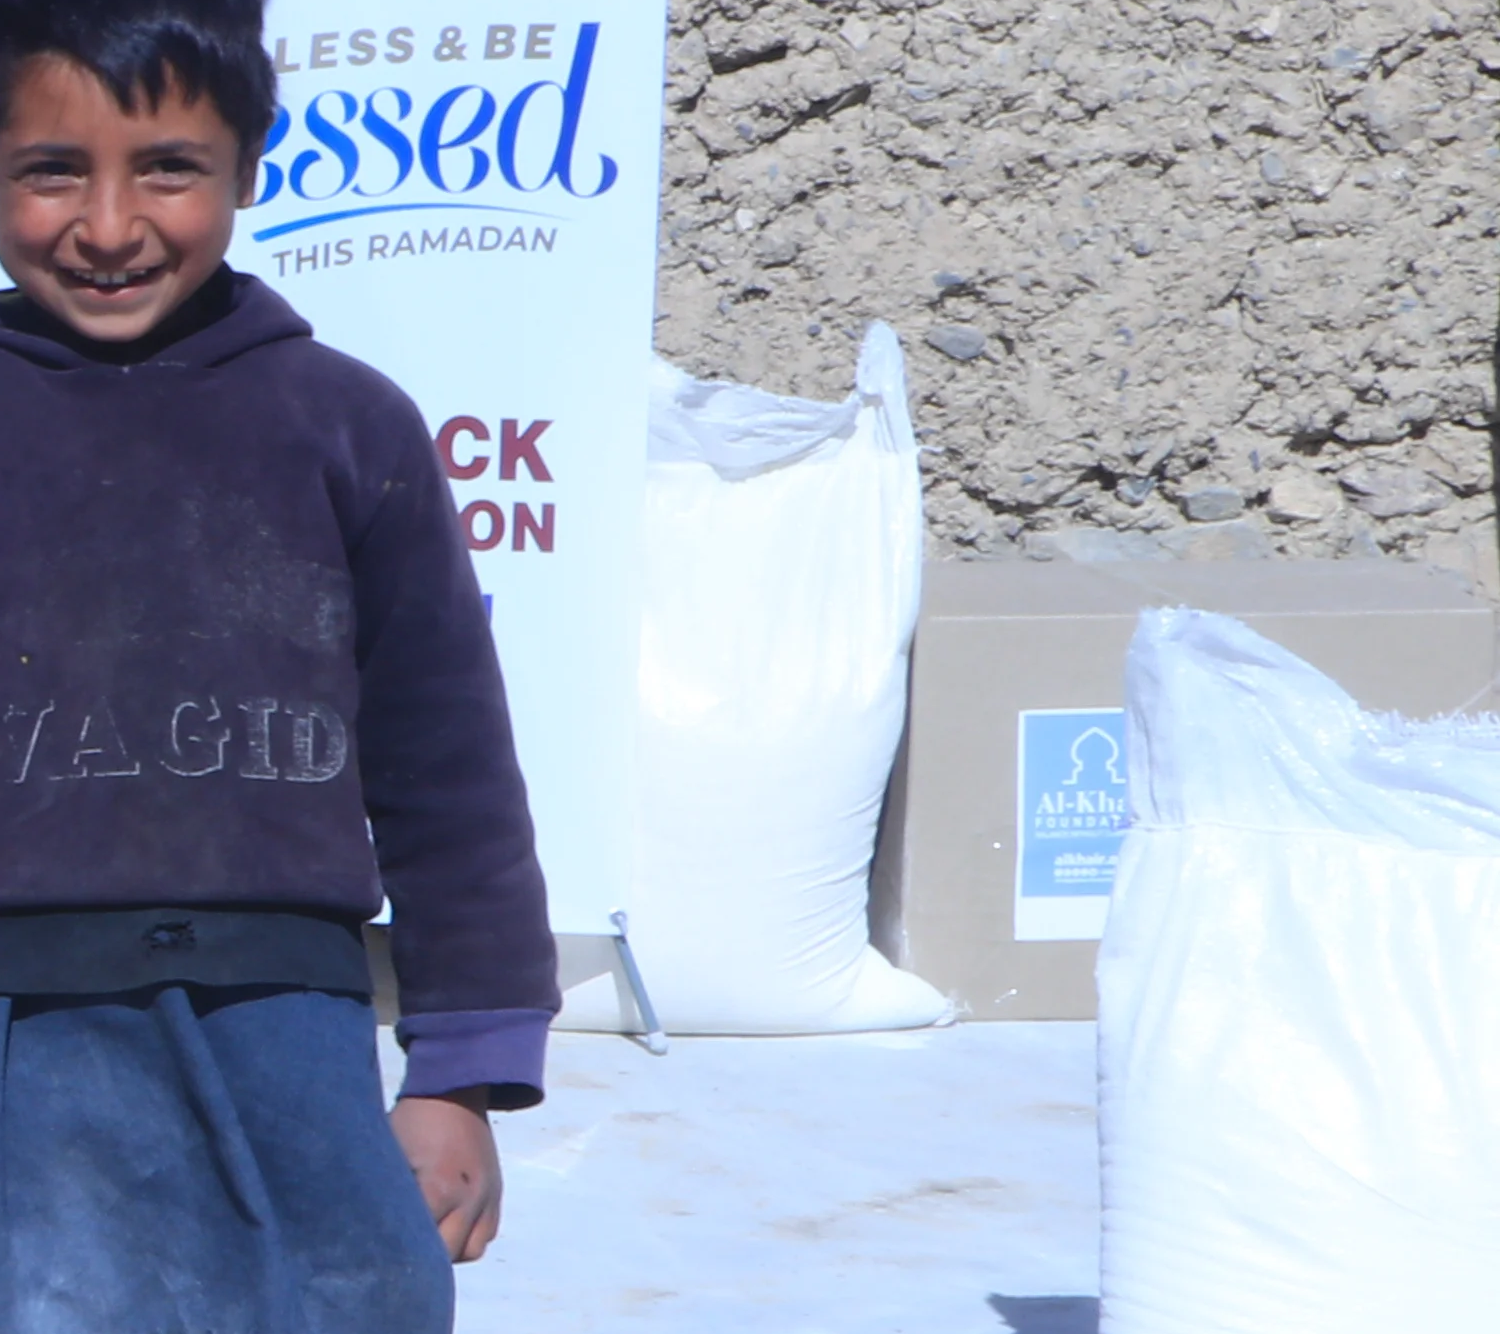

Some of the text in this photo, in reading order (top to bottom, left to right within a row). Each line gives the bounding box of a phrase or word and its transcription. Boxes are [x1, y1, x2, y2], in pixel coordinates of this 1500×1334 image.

[274, 23, 556, 74] LESS & BE
[272, 226, 557, 277] THIS RAMADAN
[434, 415, 555, 483] CK
[1035, 790, 1126, 814] Al-Kha
[1035, 814, 1121, 828] FOUNDAT
